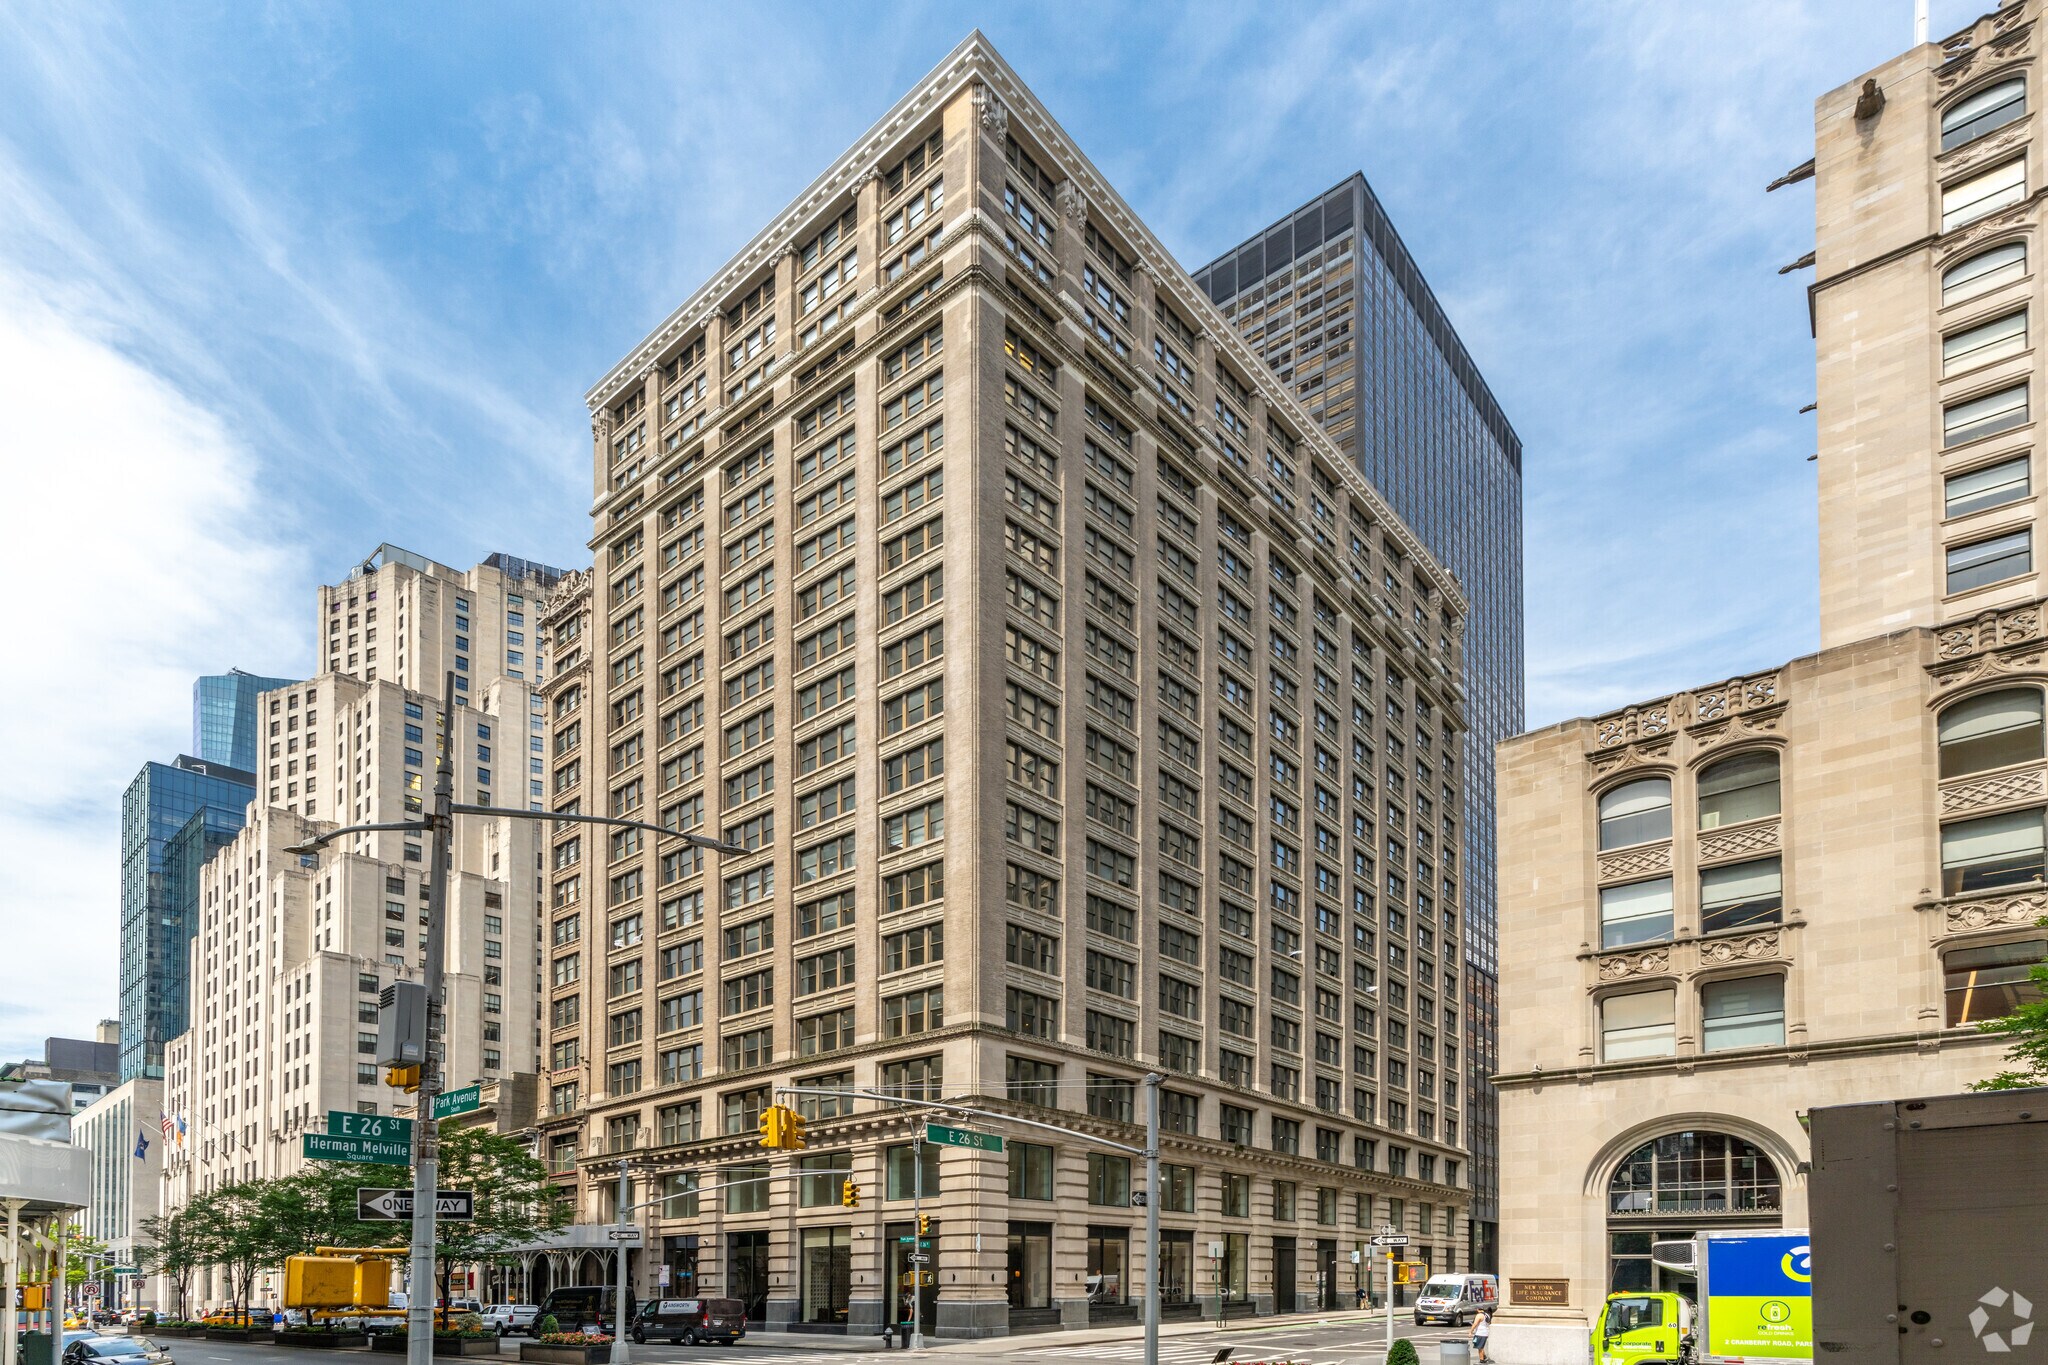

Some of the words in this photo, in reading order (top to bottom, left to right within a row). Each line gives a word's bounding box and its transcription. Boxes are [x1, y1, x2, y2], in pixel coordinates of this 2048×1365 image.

[435, 1097, 450, 1110] Park
[451, 1091, 477, 1106] Avenue
[450, 1105, 461, 1113] South
[342, 1115, 353, 1134] E
[360, 1117, 382, 1136] 26
[389, 1119, 400, 1131] St
[310, 1136, 357, 1152] Herman
[362, 1141, 408, 1157] Melville
[949, 1130, 955, 1142] E
[958, 1132, 970, 1145] 26
[973, 1135, 983, 1147] St
[346, 1152, 374, 1161] Square
[382, 1198, 413, 1211] ONE
[436, 1200, 460, 1211] AY
[1468, 1279, 1495, 1303] FedEx
